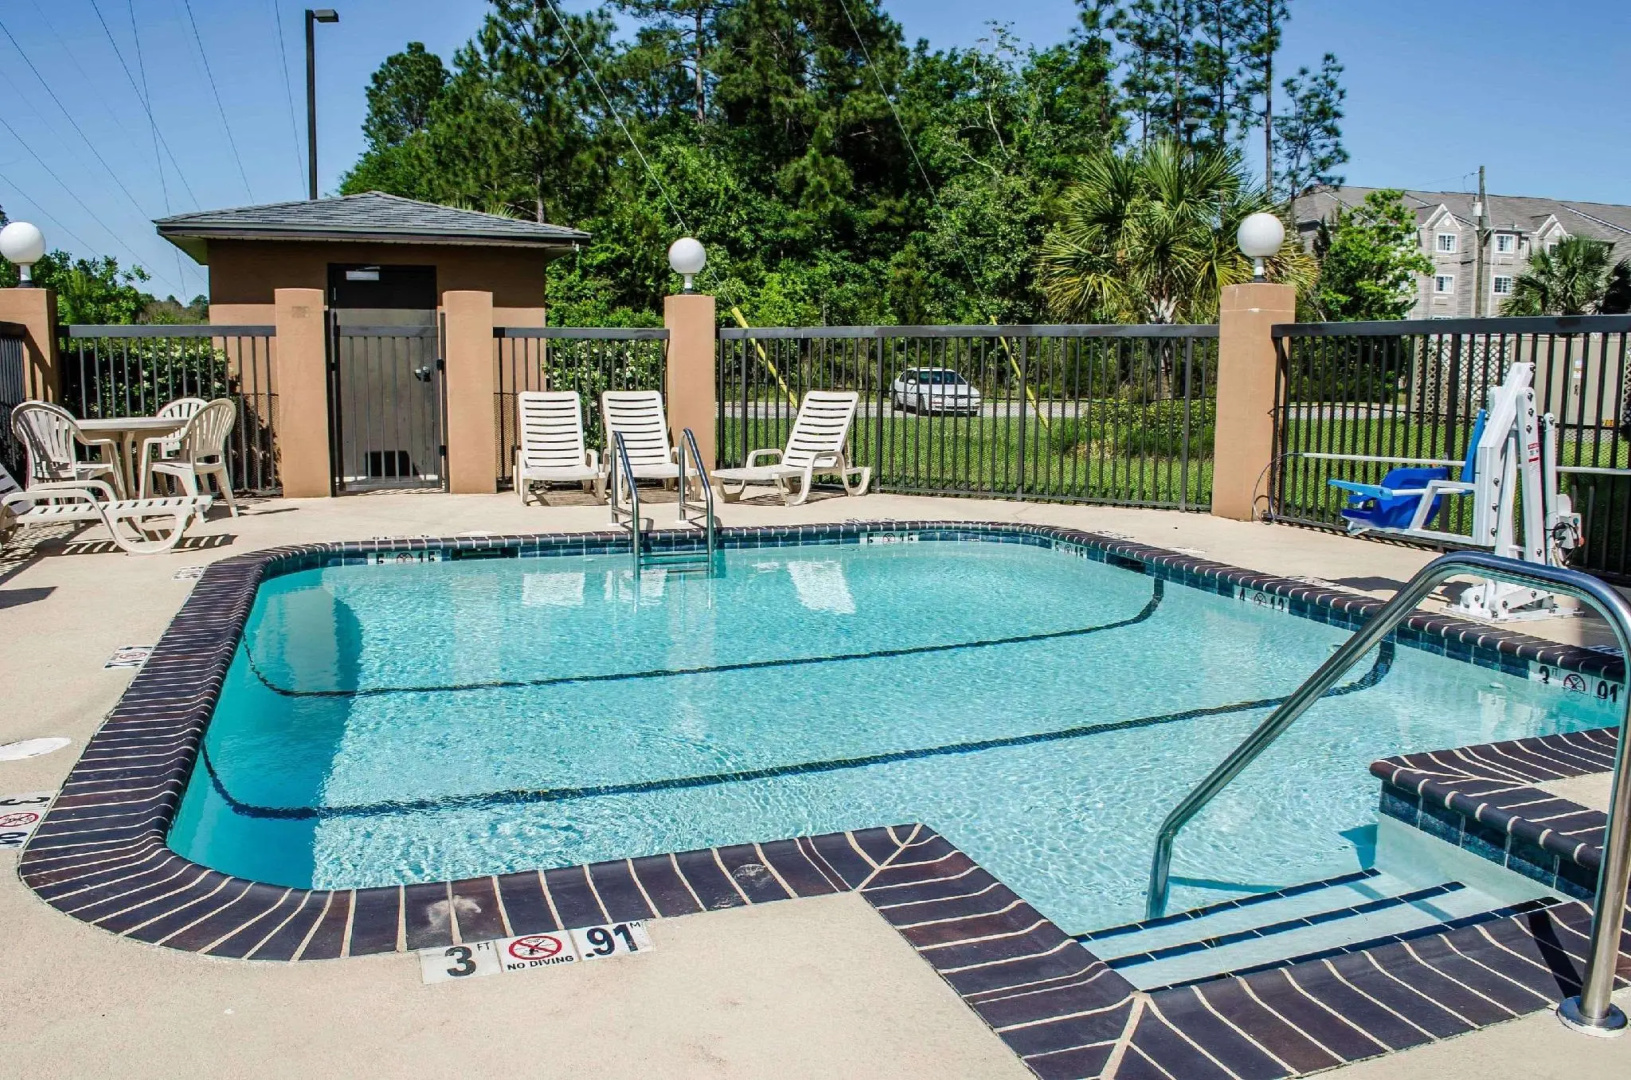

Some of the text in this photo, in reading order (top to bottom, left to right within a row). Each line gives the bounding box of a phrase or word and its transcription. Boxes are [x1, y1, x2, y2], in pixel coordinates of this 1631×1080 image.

[444, 940, 491, 977] 3 FT
[585, 921, 641, 959] .91 M
[507, 955, 574, 971] NO DIVING
